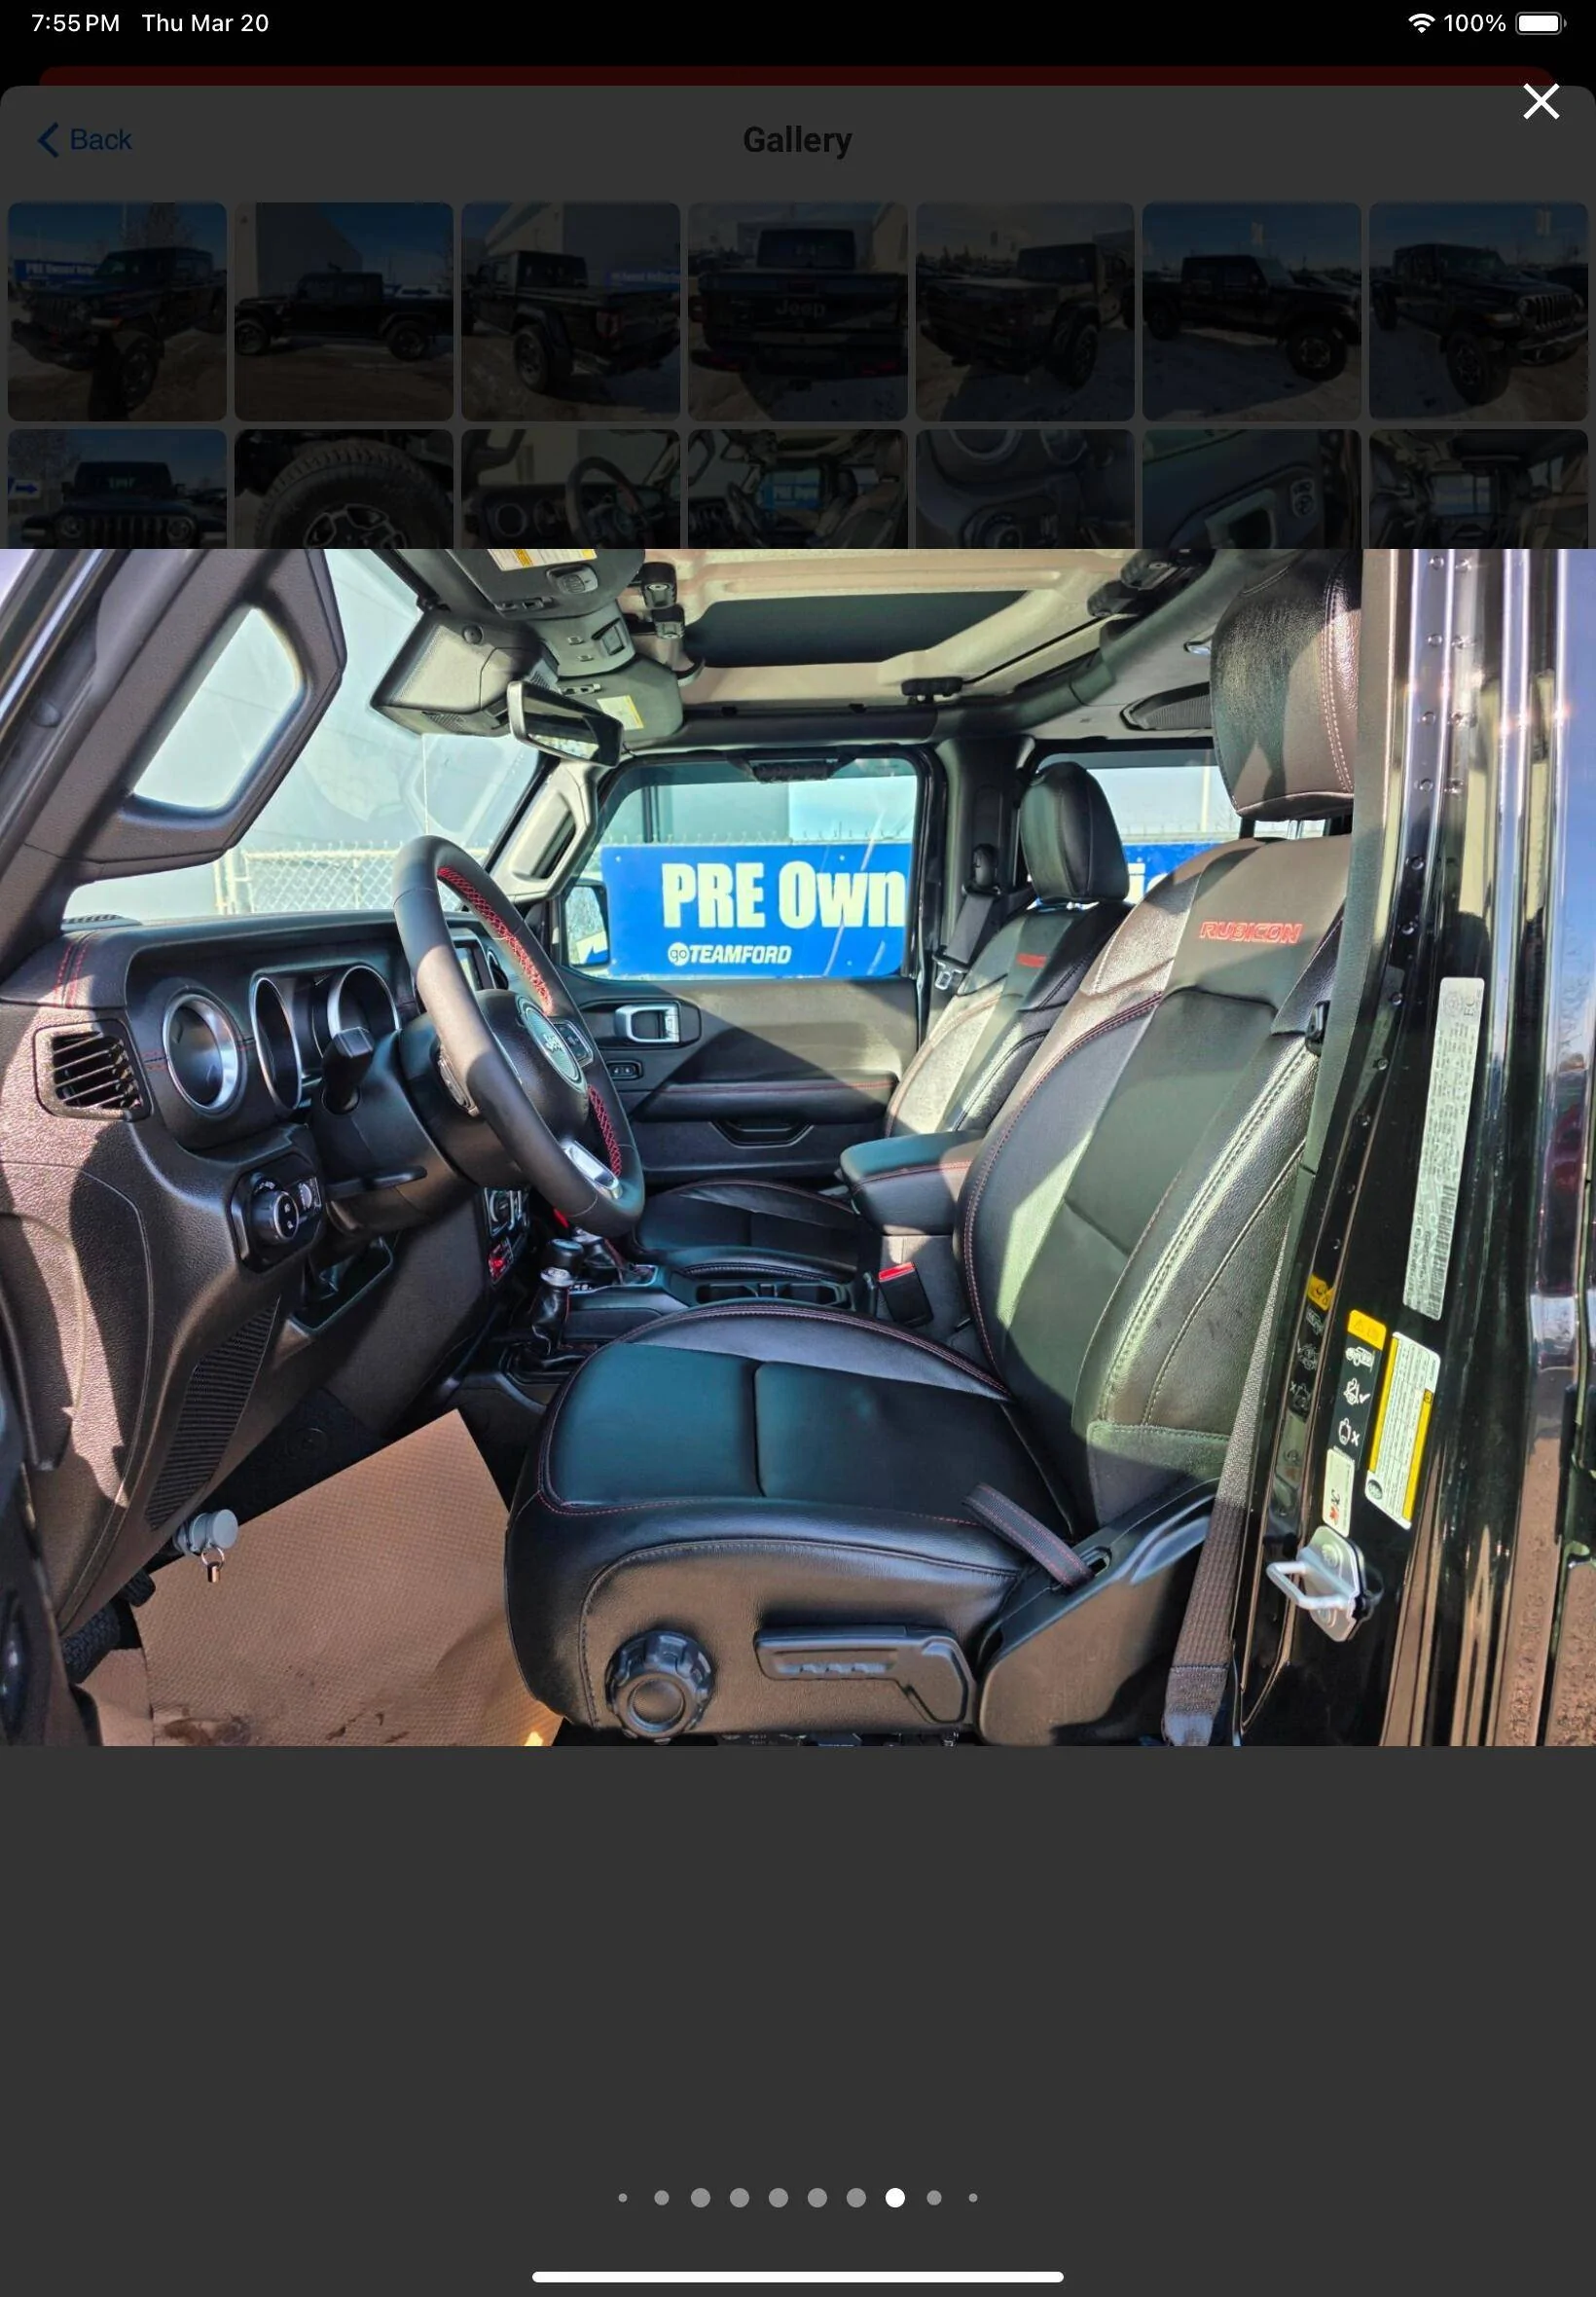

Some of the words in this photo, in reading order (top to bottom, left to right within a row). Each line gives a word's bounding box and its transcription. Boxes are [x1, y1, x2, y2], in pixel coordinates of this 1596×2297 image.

[31, 14, 81, 32] 7:55
[86, 14, 120, 32] PM
[141, 13, 183, 32] Thu
[191, 14, 235, 32] Mar
[240, 14, 270, 33] 20
[1443, 14, 1506, 33] 100%
[70, 127, 133, 152] Back
[743, 124, 853, 161] Gallery
[661, 862, 766, 929] PRE
[779, 860, 906, 930] Own
[1199, 921, 1303, 944] RUBICON
